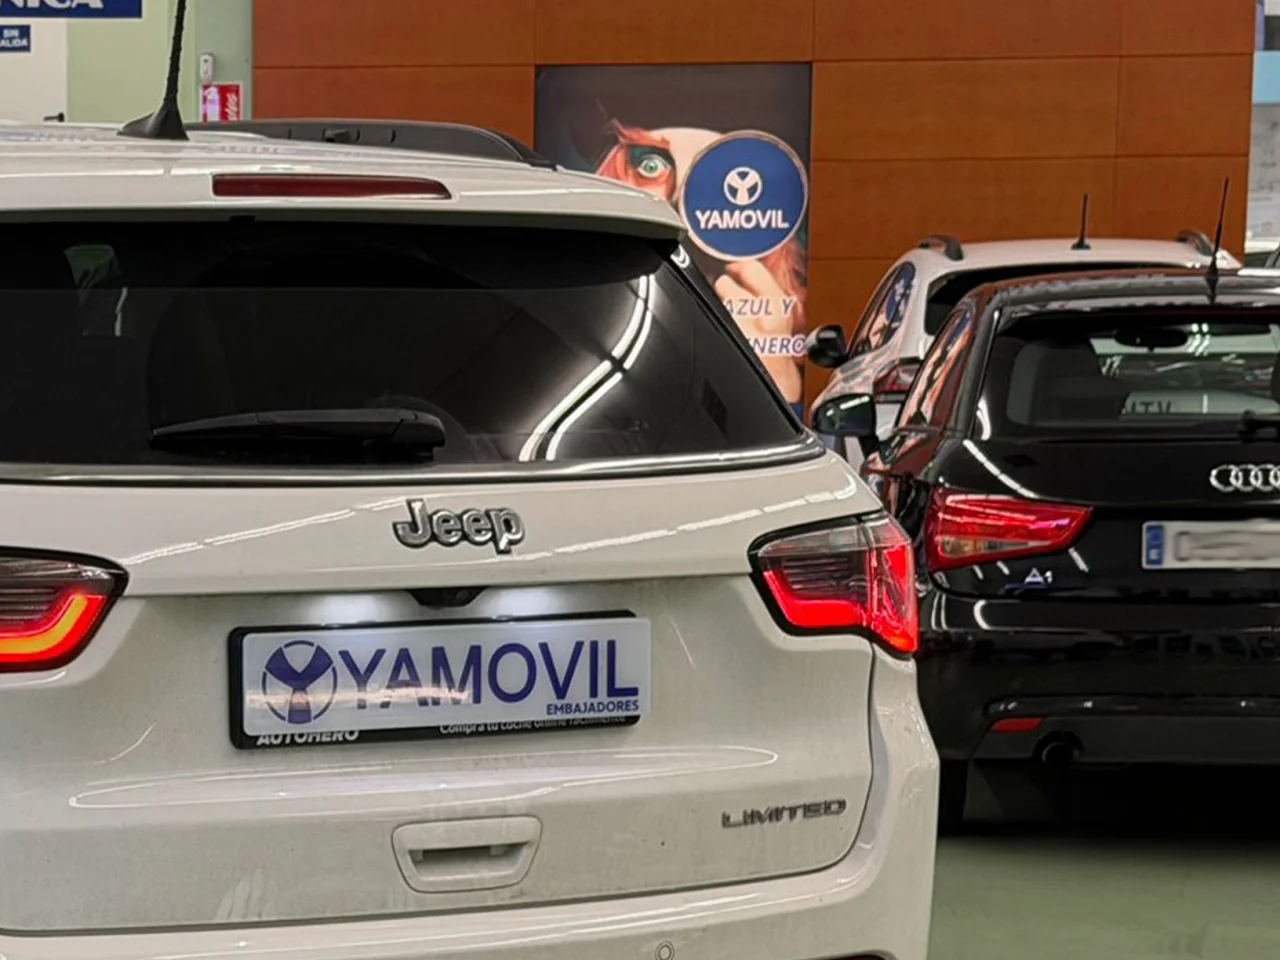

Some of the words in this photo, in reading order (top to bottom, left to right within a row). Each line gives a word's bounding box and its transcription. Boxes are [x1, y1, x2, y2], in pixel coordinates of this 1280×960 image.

[695, 210, 790, 229] YAMOVIL
[748, 336, 807, 354] NERO
[392, 498, 526, 555] Jeep
[1024, 567, 1053, 585] A1
[338, 639, 640, 710] YAMOVIL
[545, 700, 640, 716] EMBAJADORES
[721, 799, 847, 829] LIMITED
